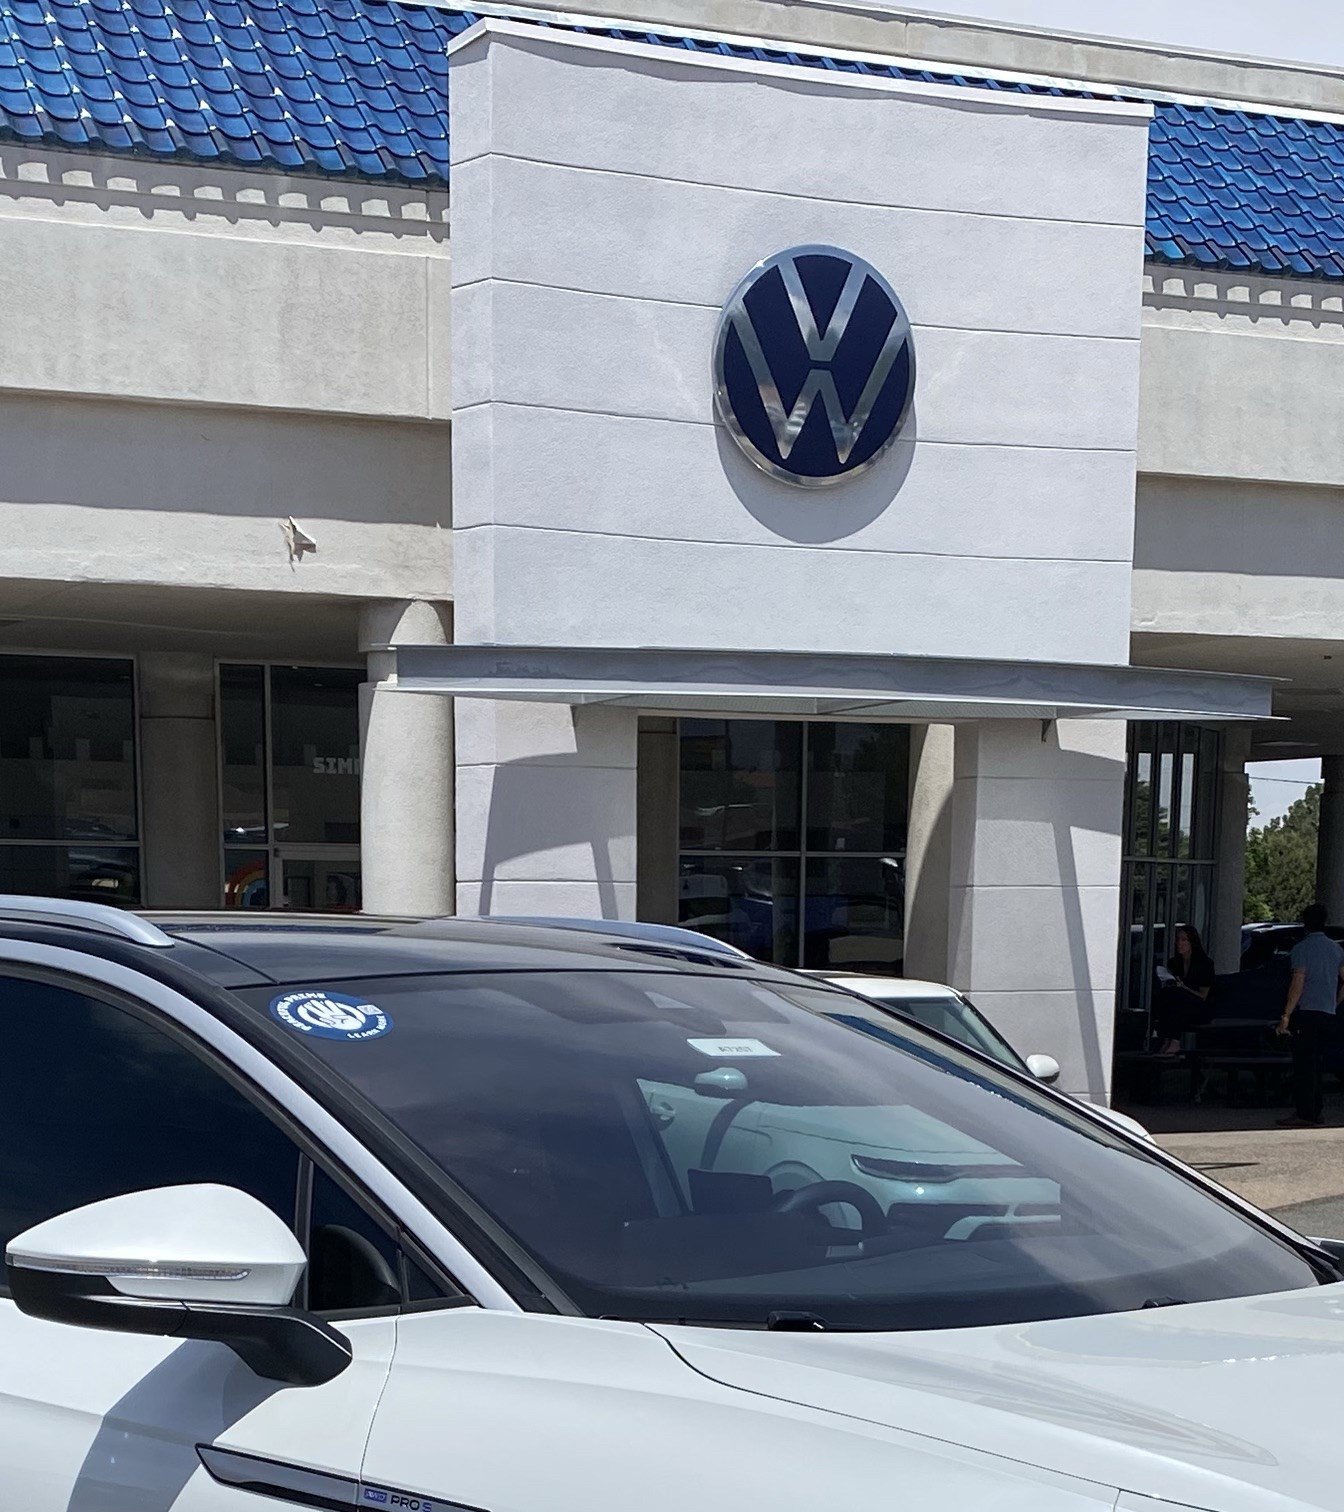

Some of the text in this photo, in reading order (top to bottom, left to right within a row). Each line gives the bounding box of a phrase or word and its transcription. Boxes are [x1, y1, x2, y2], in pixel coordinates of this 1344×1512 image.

[714, 247, 914, 484] VW
[347, 1028, 380, 1039] LEARN
[391, 1495, 420, 1511] PRO
